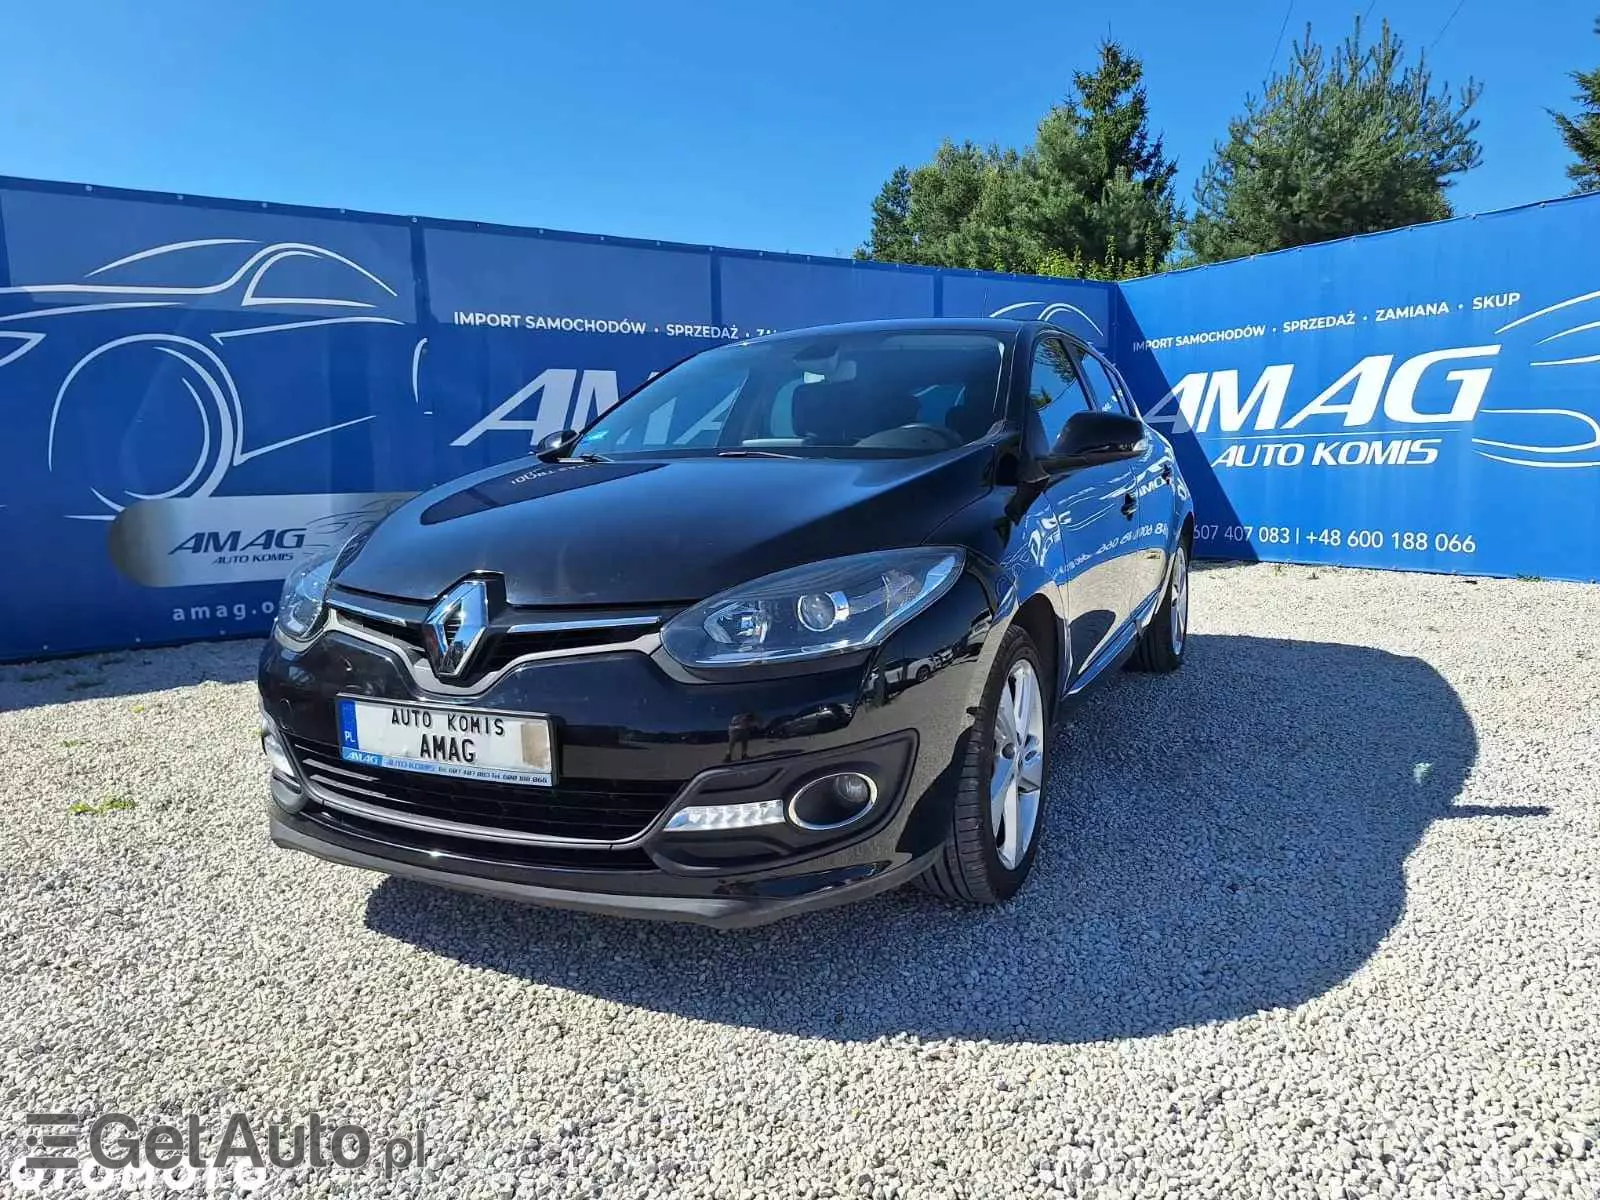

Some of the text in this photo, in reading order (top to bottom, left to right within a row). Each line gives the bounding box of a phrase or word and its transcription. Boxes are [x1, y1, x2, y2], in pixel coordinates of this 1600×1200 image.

[453, 311, 522, 329] IMPORT
[525, 314, 647, 335] SAMOCHODÓW
[666, 324, 739, 340] SPRZEDAŻ
[1132, 292, 1521, 352] IMPORT SAMOCHODÓW SPRZEDAŻ ZAMIANA SKUP
[1212, 438, 1442, 468] AUTO KOMIS
[1224, 525, 1254, 542] 407
[1258, 526, 1290, 544] 083
[1305, 528, 1342, 547] +48
[1347, 530, 1384, 549] 600
[1391, 532, 1429, 551] 188
[1435, 533, 1476, 553] 066
[212, 552, 294, 565] AUTO KOMIS
[172, 601, 275, 621] amag.o
[391, 708, 505, 736] AUTO KOMIS
[344, 730, 356, 743] PL
[420, 734, 477, 764] AMAG
